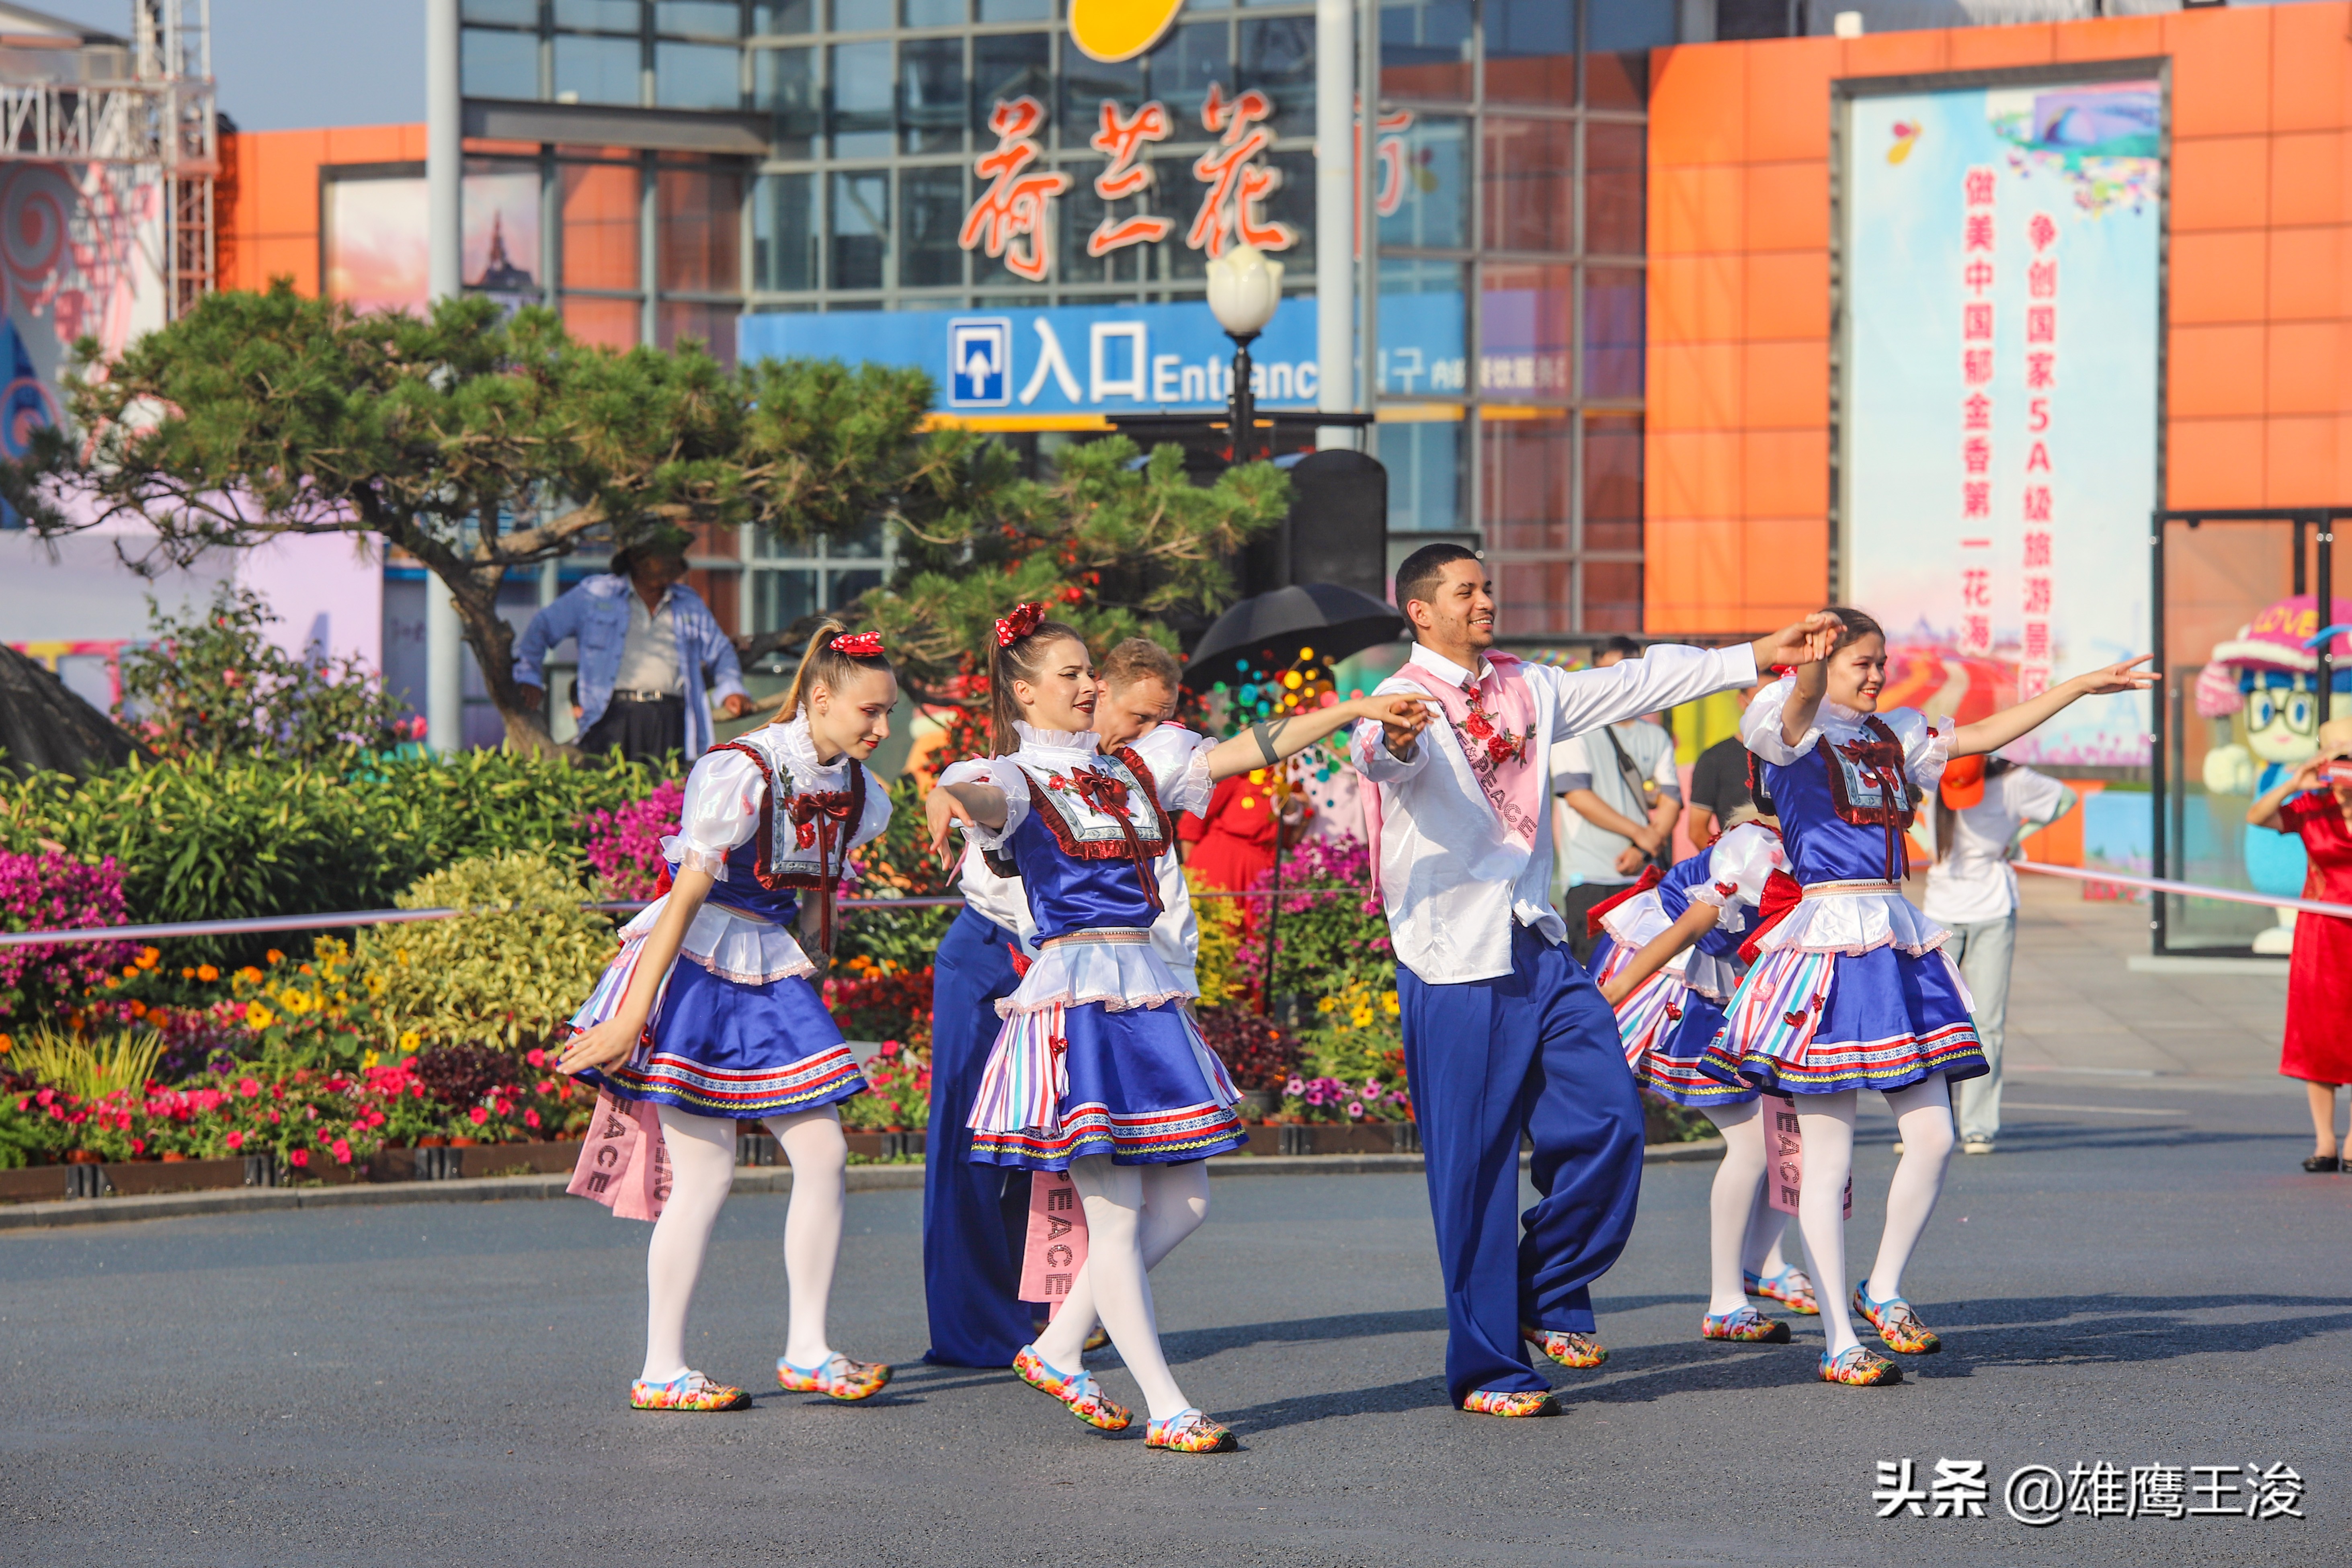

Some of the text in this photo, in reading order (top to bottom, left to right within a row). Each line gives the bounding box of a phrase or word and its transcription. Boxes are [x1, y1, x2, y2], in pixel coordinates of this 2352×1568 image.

[1019, 318, 1317, 404] 入口 Entranc
[1960, 171, 1995, 649] 做美中国郁金香第一花海
[2023, 214, 2056, 701] 争创国家5A级旅游景区
[2252, 606, 2319, 638] LOVE
[587, 1096, 634, 1193] EACE
